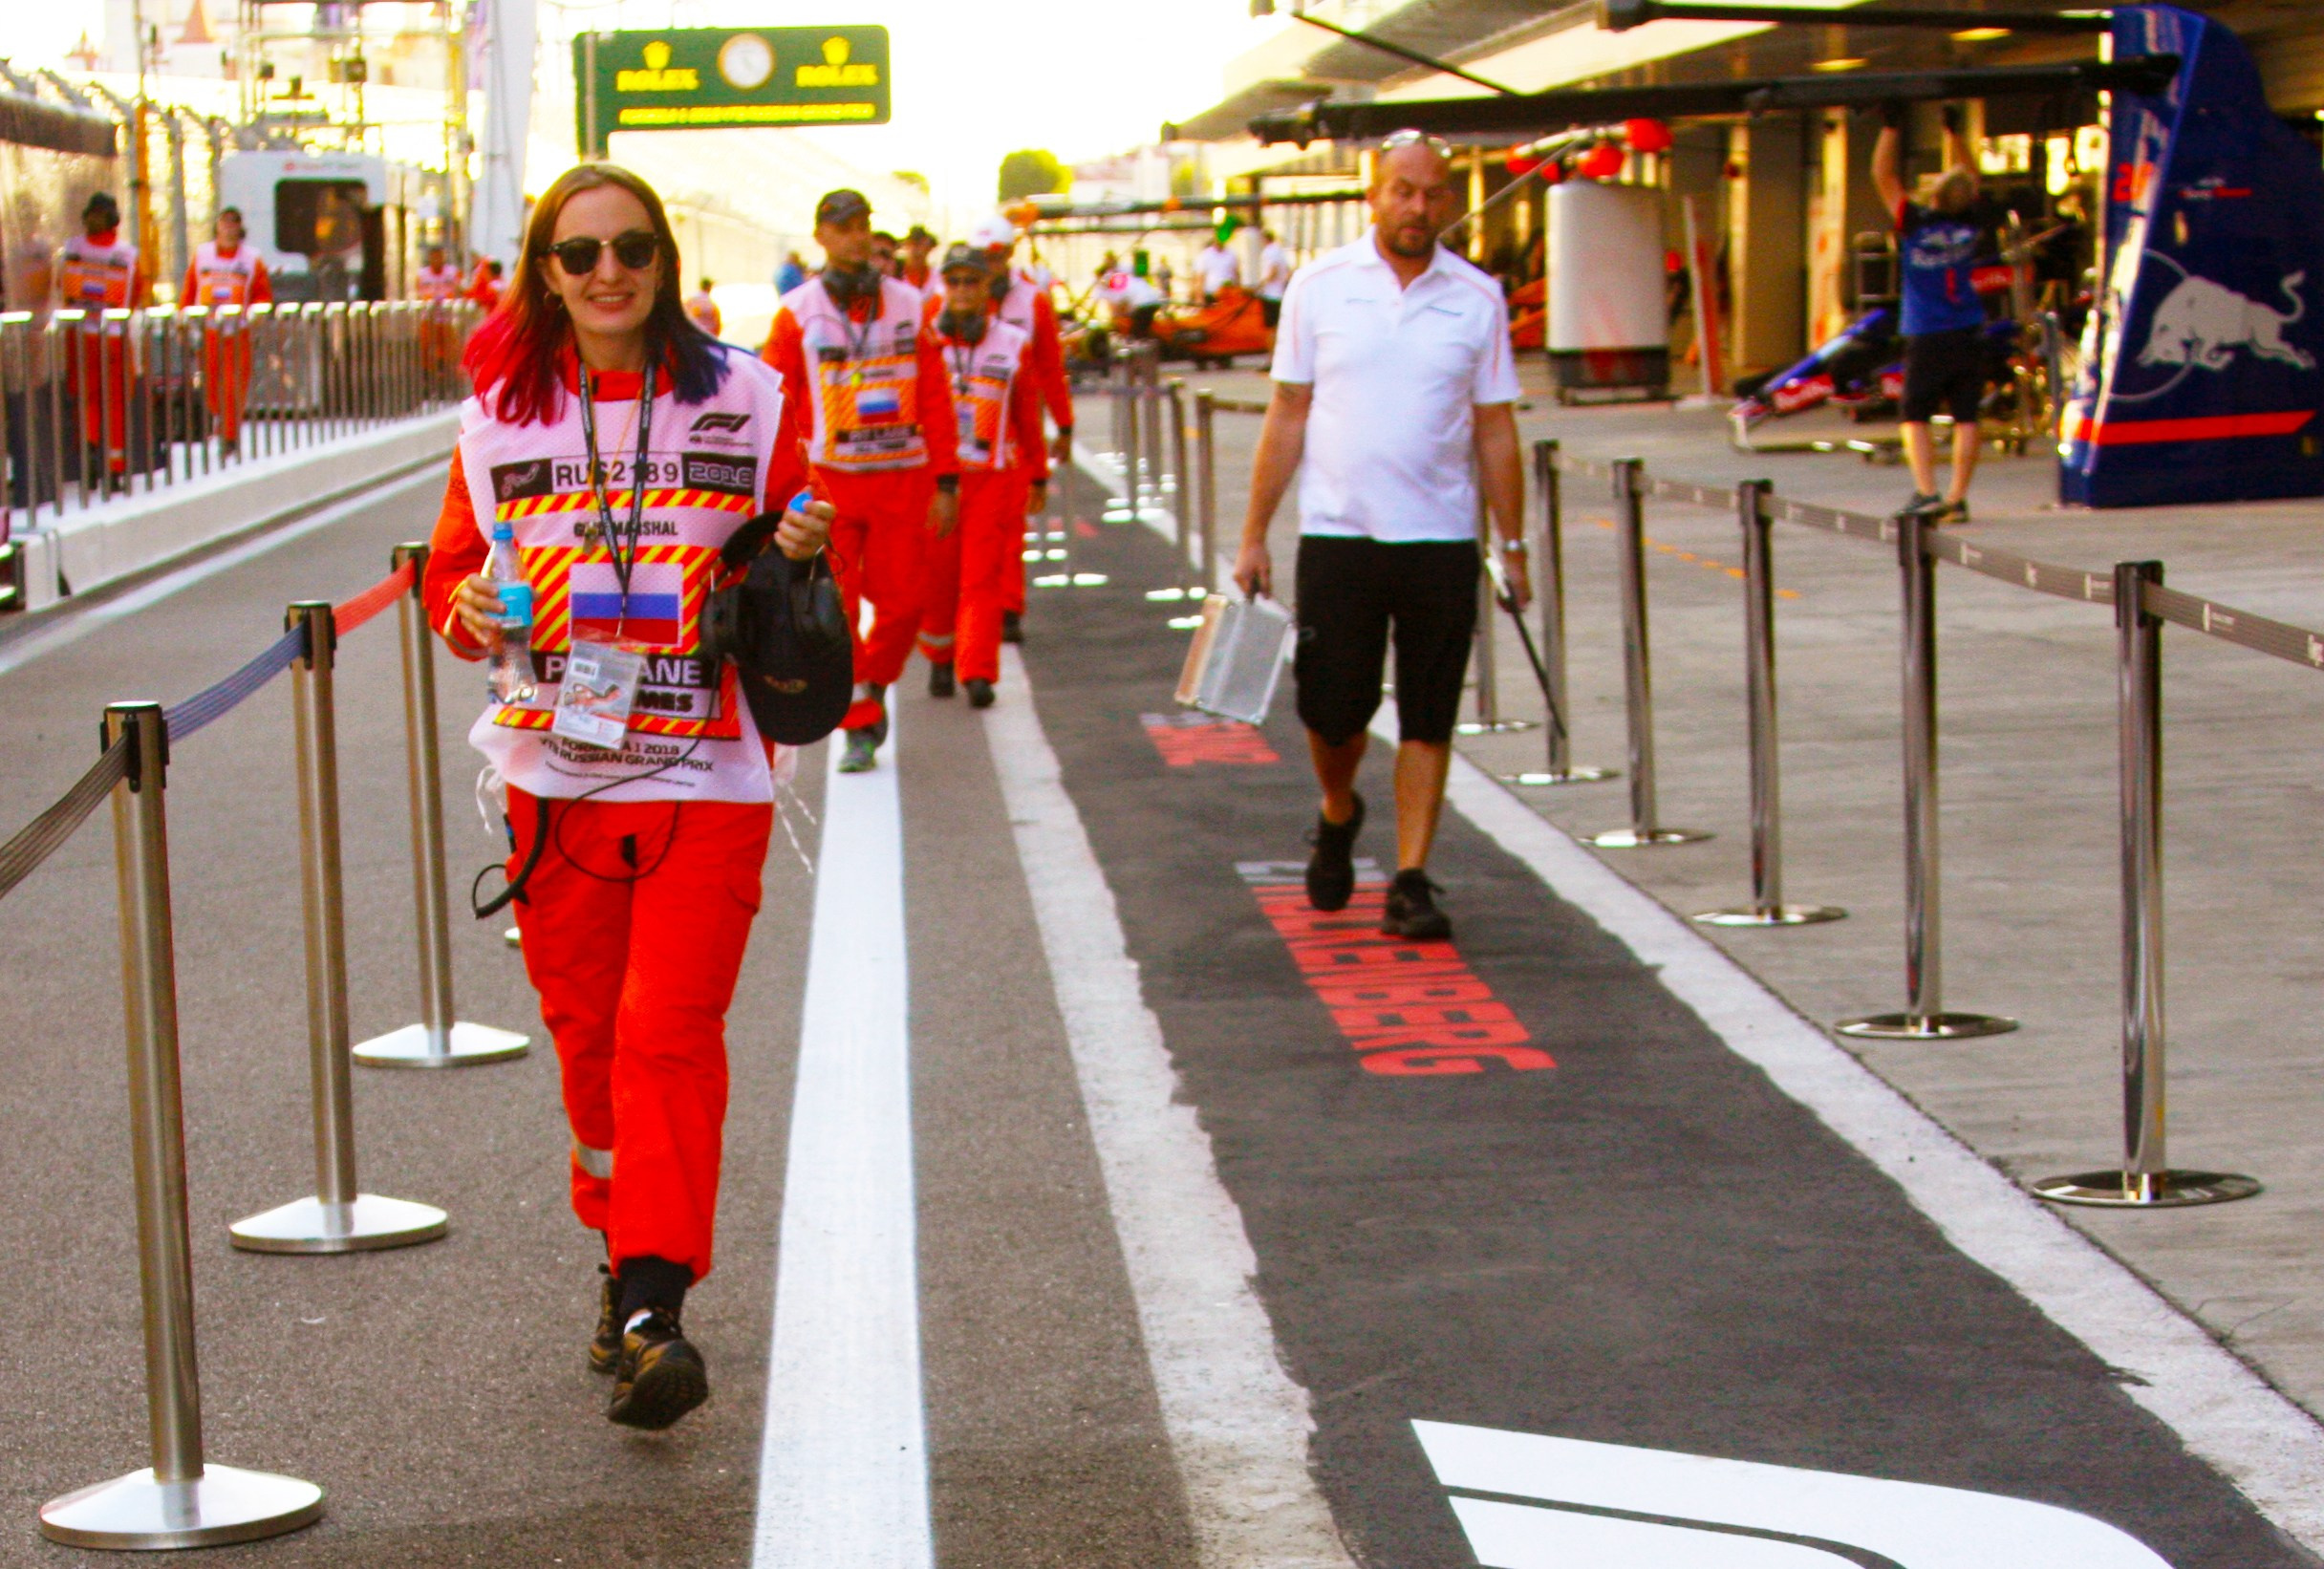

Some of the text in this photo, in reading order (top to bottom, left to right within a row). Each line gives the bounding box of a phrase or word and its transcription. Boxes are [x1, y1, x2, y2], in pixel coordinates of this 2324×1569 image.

[616, 69, 699, 91] ROLEX
[796, 64, 878, 87] ROLEX
[638, 658, 700, 685] ANE
